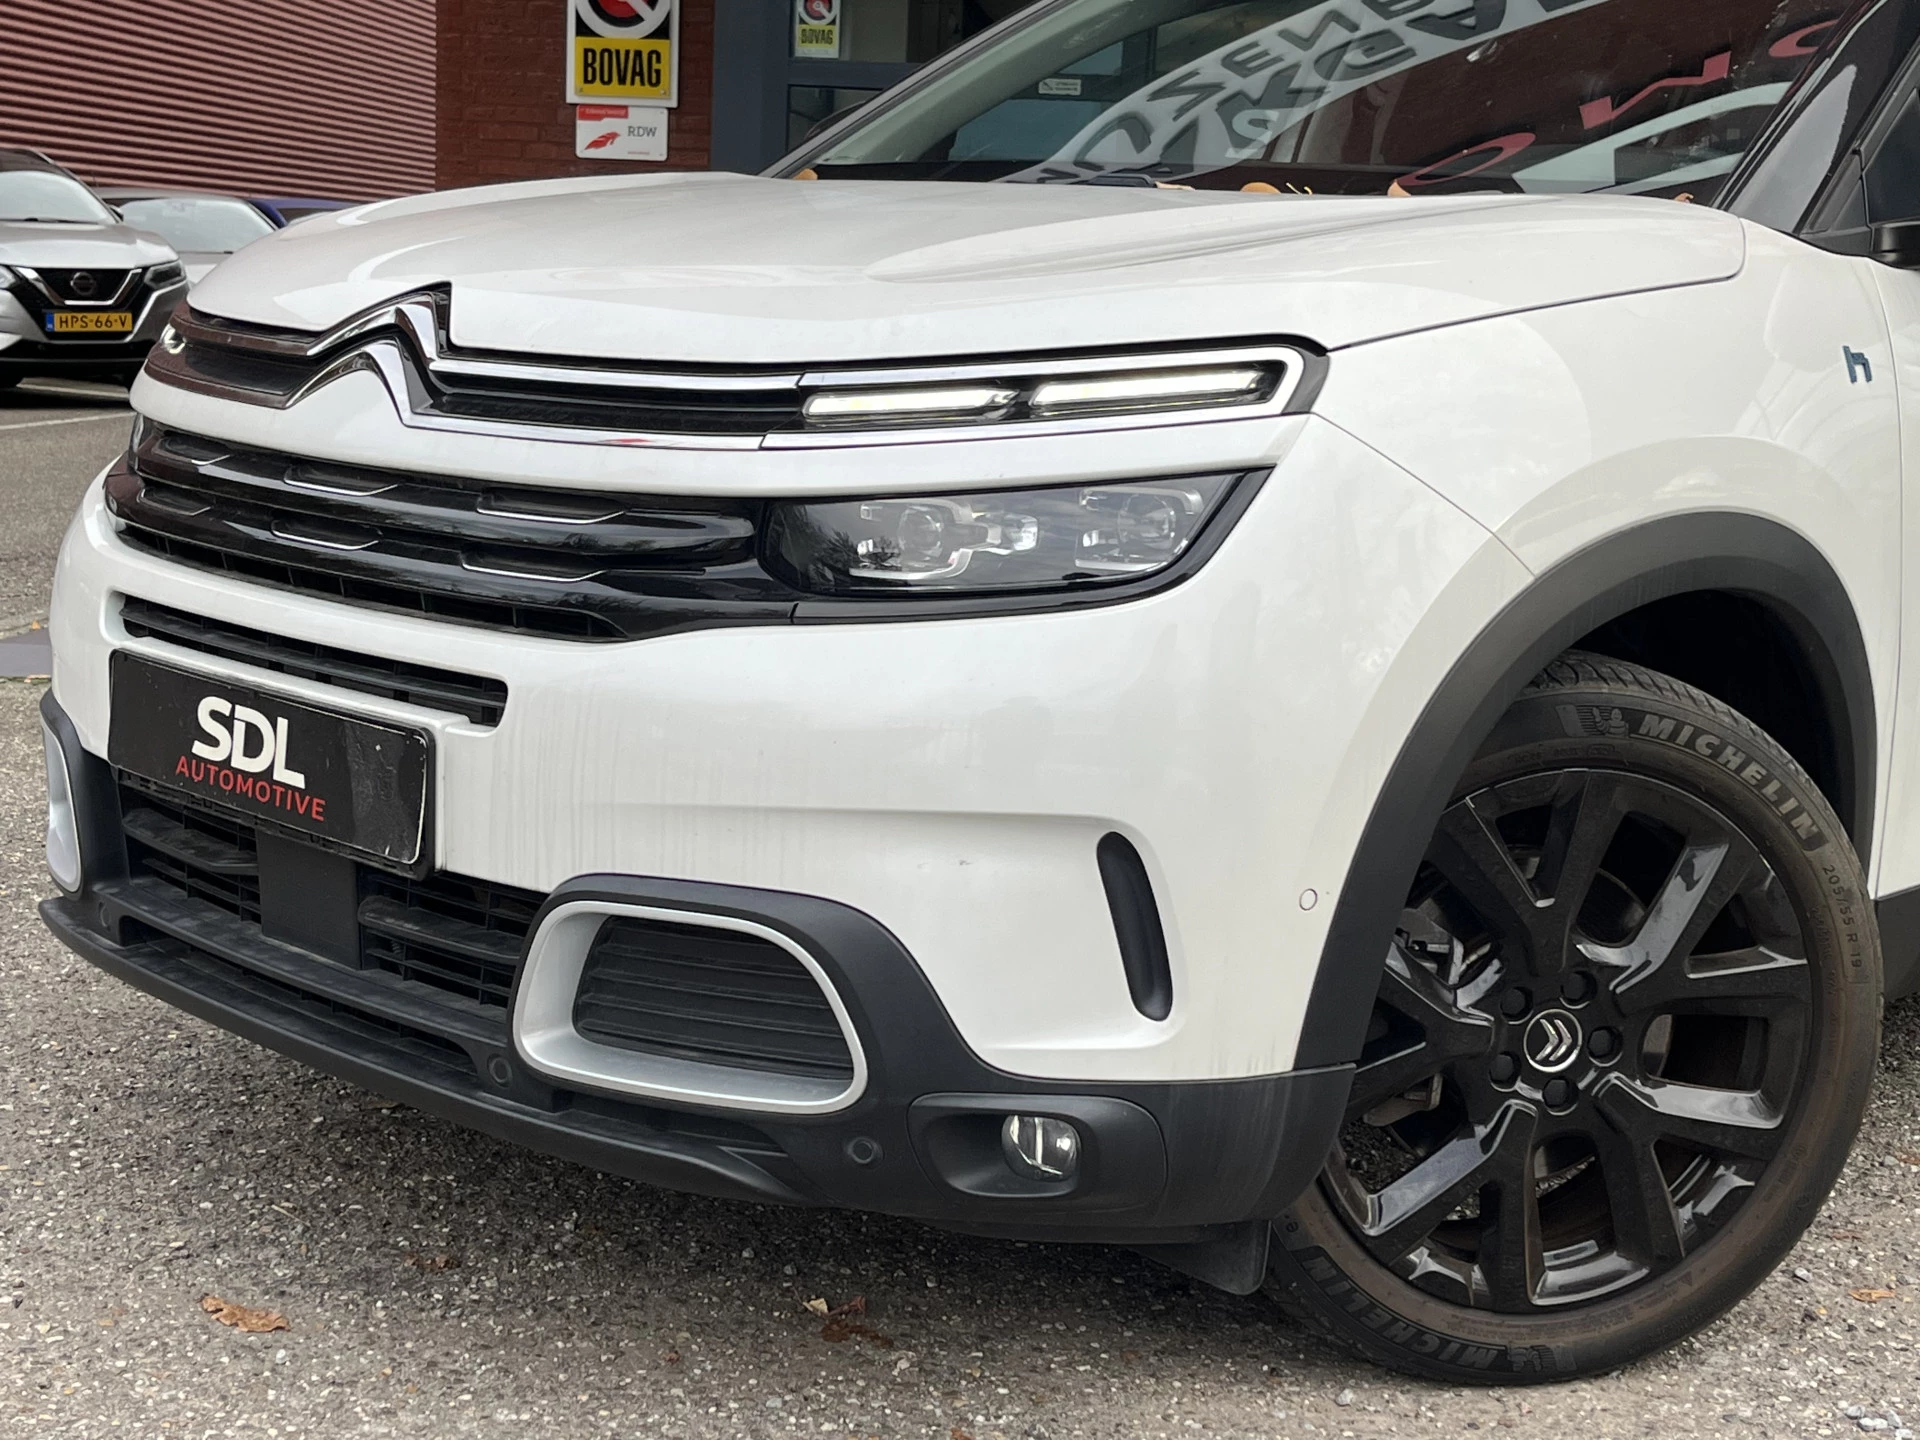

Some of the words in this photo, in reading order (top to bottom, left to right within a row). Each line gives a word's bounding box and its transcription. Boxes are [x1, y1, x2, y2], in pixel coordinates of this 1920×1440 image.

[801, 29, 834, 45] BOVAG
[583, 48, 662, 88] BOVAG
[627, 125, 658, 138] RDW
[59, 314, 127, 329] HPS-66-V
[191, 695, 306, 790] SDL
[175, 755, 327, 822] AUTOMOTIVE
[1638, 713, 1821, 841] MICHELIN
[1822, 864, 1856, 926] 205/55
[1846, 932, 1859, 943] R
[1850, 952, 1863, 969] 19
[1301, 1255, 1500, 1371] MICHELIN
